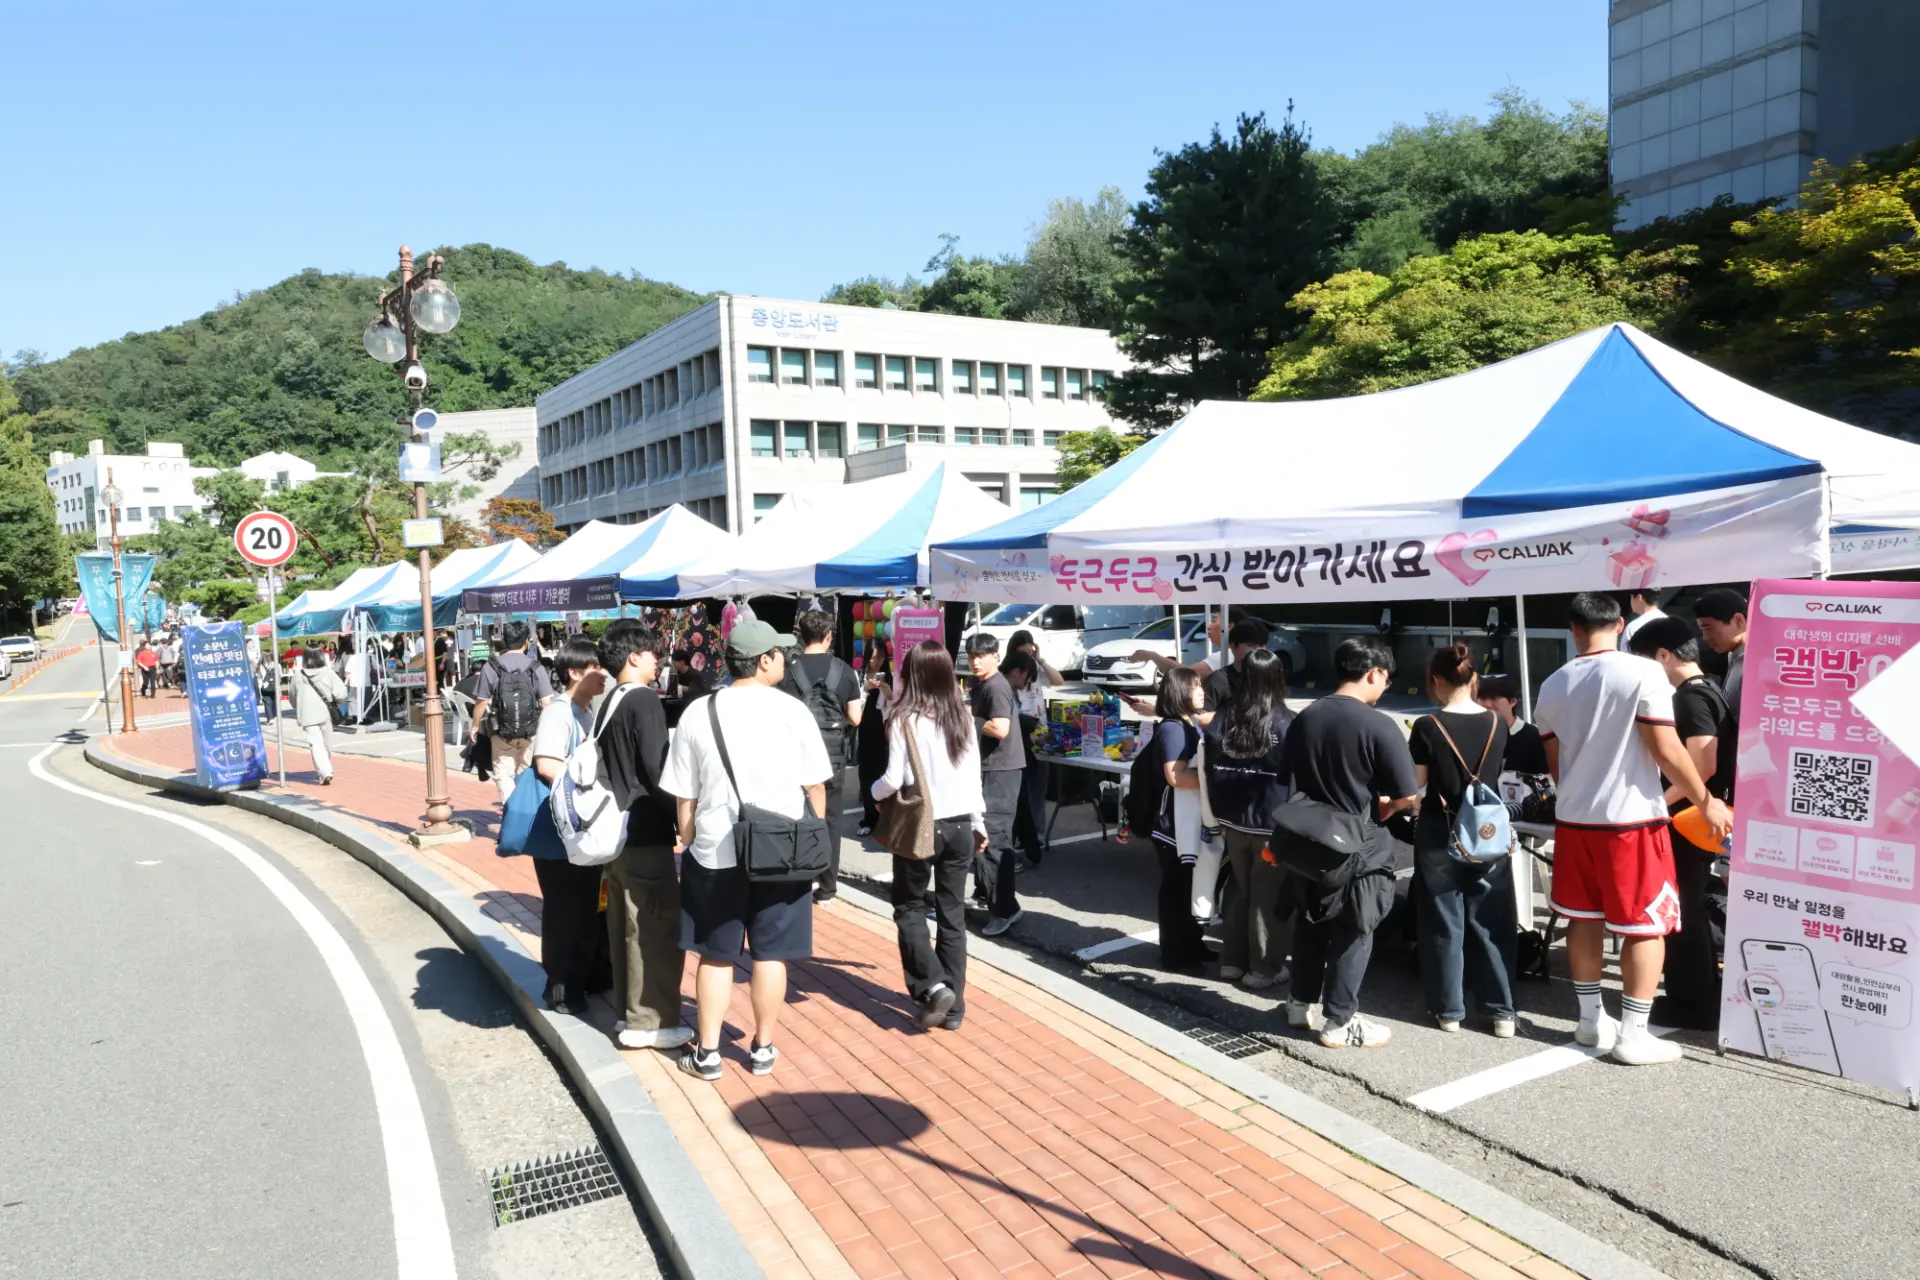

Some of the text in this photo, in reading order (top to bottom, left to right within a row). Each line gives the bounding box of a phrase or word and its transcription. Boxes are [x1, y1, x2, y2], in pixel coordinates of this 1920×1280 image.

[752, 308, 839, 332] 중앙도서관
[251, 527, 282, 550] 20
[1498, 541, 1574, 560] CALVAK
[1056, 540, 1431, 593] 두근두근 간식 받아가세요
[507, 591, 519, 606] 타로
[525, 589, 537, 606] 사주
[1825, 603, 1883, 615] CALVAK
[203, 640, 229, 651] 소문난
[1784, 629, 1902, 646] 대학생의 디지털 선배
[192, 650, 244, 665] 연애운 맛집
[1763, 695, 1843, 718] 두근두근
[1759, 717, 1837, 741] 리워드를
[1743, 889, 1846, 920] 우리 만날 일정을
[1801, 919, 1908, 955] 캘박해봐요
[1841, 995, 1888, 1016] 한눈에!
